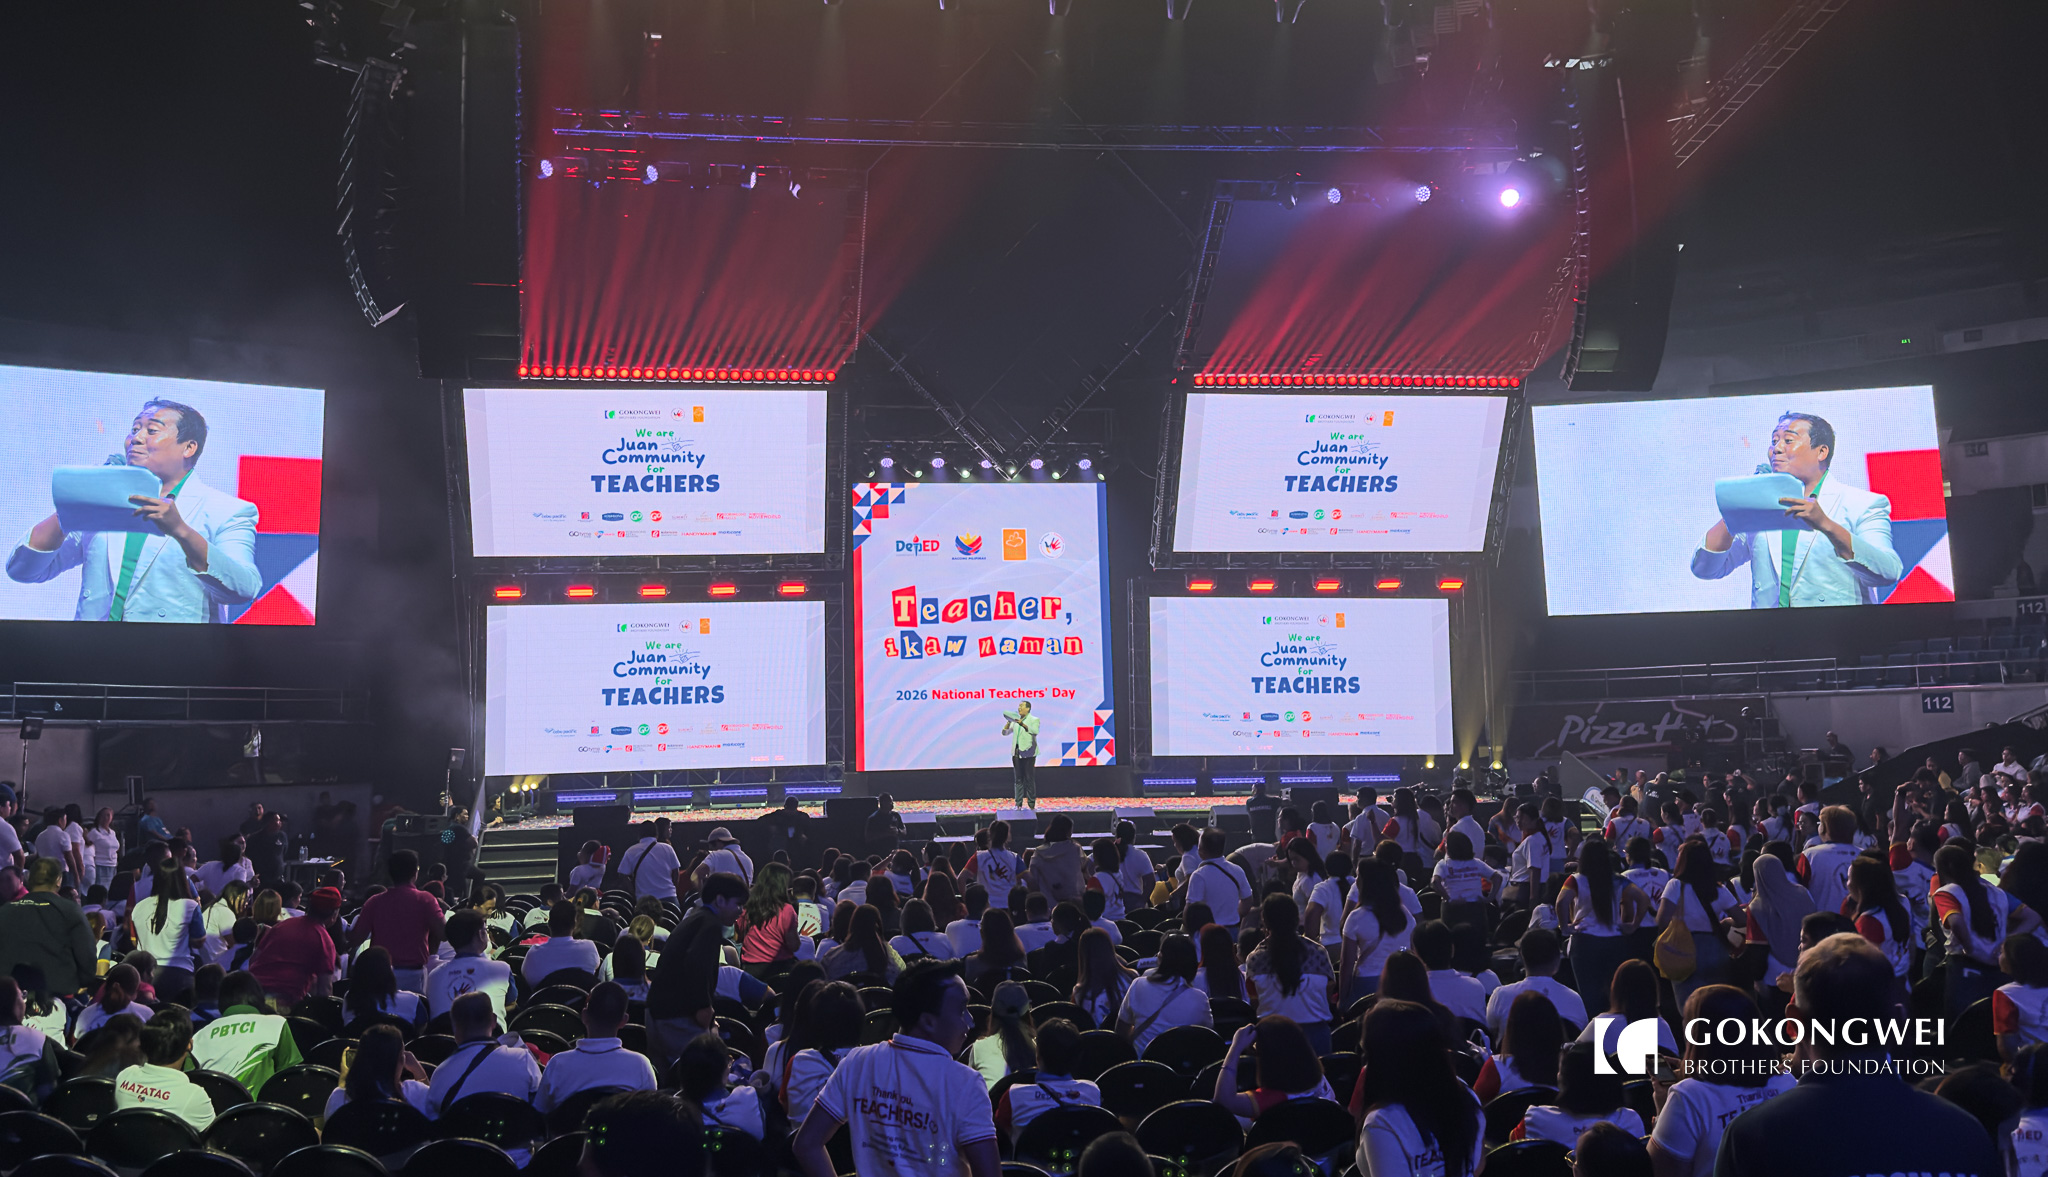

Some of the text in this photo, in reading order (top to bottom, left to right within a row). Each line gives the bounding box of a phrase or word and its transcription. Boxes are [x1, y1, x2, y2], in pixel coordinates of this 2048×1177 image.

[635, 428, 652, 437] We
[1330, 432, 1345, 440] We
[616, 437, 658, 452] Juan
[1310, 440, 1348, 453] Juan
[602, 448, 705, 469] Community
[1297, 450, 1389, 470] Community
[646, 464, 665, 473] for
[1335, 466, 1351, 474] for
[590, 474, 720, 493] TEACHERS
[1284, 475, 1398, 492] TEACHERS
[893, 592, 1072, 626] Teacher,
[2018, 602, 2044, 614] 112
[1288, 633, 1302, 642] We
[645, 641, 662, 650] We
[885, 633, 1082, 658] ikaw naman
[1272, 642, 1308, 654] Juan
[626, 650, 667, 664] Juan
[1260, 652, 1347, 672] Community
[613, 662, 711, 680] Community
[1298, 666, 1313, 676] for
[655, 676, 673, 686] for
[1251, 676, 1361, 694] TEACHERS
[601, 685, 725, 706] TEACHERS
[896, 687, 1076, 700] 2026 National Teachers' Day
[1924, 696, 1952, 710] 112
[1557, 711, 1726, 748] Pizza Ht
[210, 1021, 256, 1039] PBTCI
[120, 1080, 171, 1101] MATATAG
[872, 1086, 897, 1100] Thank
